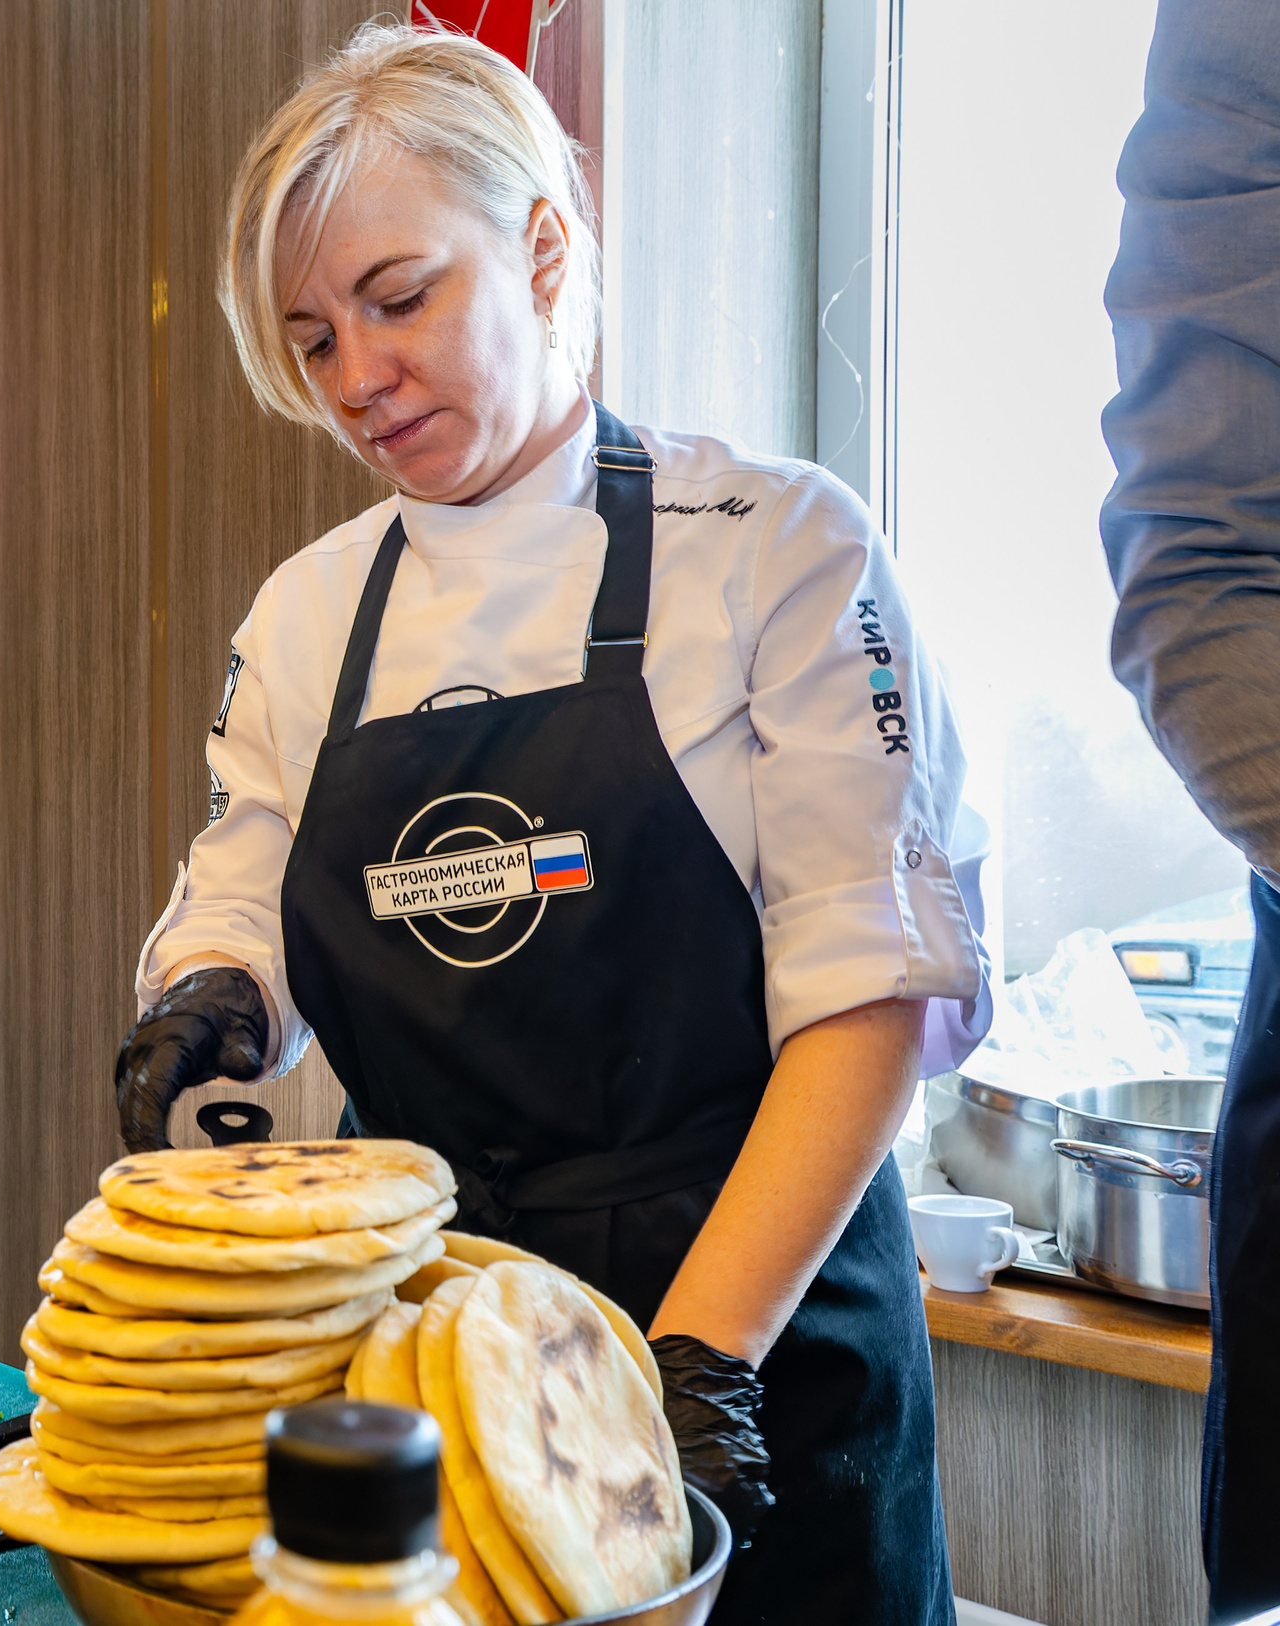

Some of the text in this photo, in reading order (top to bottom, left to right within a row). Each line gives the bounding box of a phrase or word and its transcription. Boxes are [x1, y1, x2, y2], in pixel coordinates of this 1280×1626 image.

[370, 852, 525, 890] ГАСТРОНОМИЧЕСКАЯ
[391, 877, 505, 908] КАРТА РОССИИ
